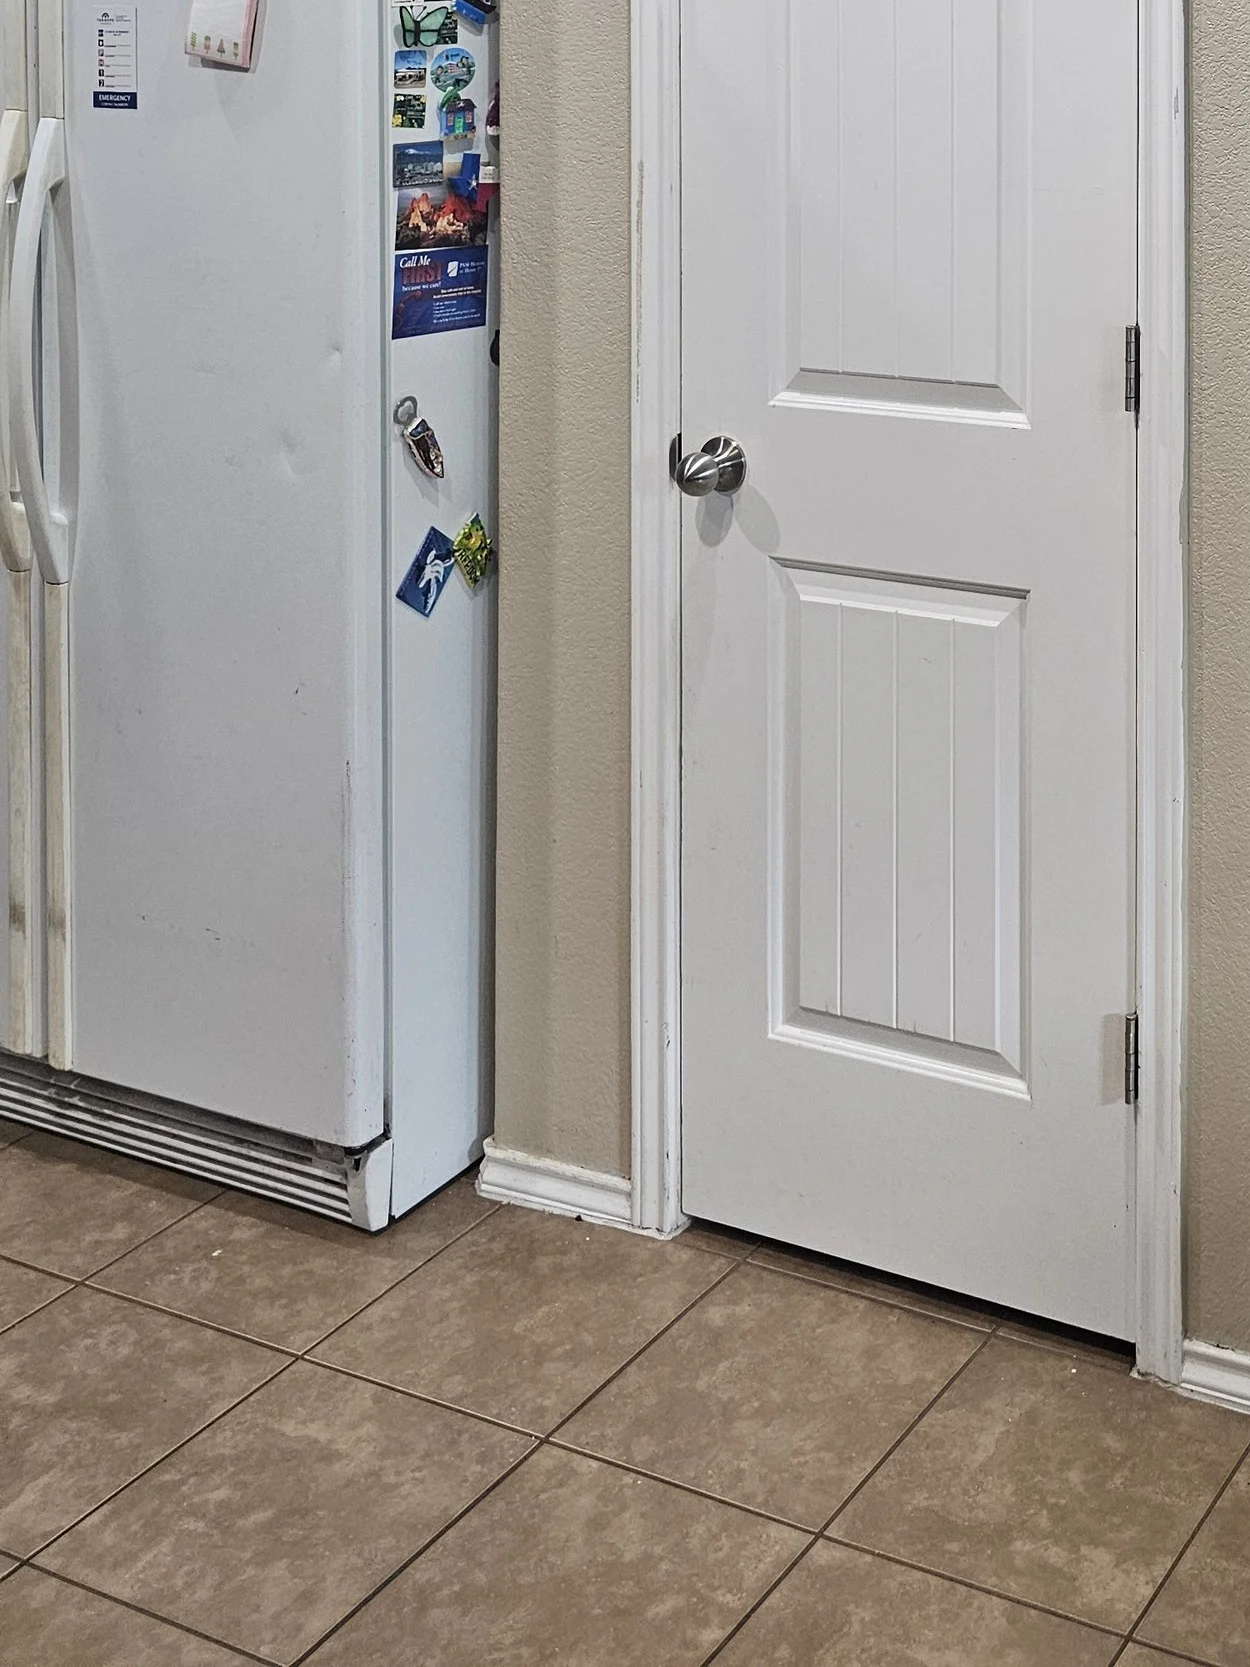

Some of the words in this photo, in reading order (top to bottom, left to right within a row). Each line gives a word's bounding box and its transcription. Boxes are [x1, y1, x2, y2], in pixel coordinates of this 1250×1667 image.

[98, 94, 131, 102] EMERGENCY
[400, 255, 418, 268] Call
[418, 255, 431, 267] Me
[402, 261, 442, 285] FIRST
